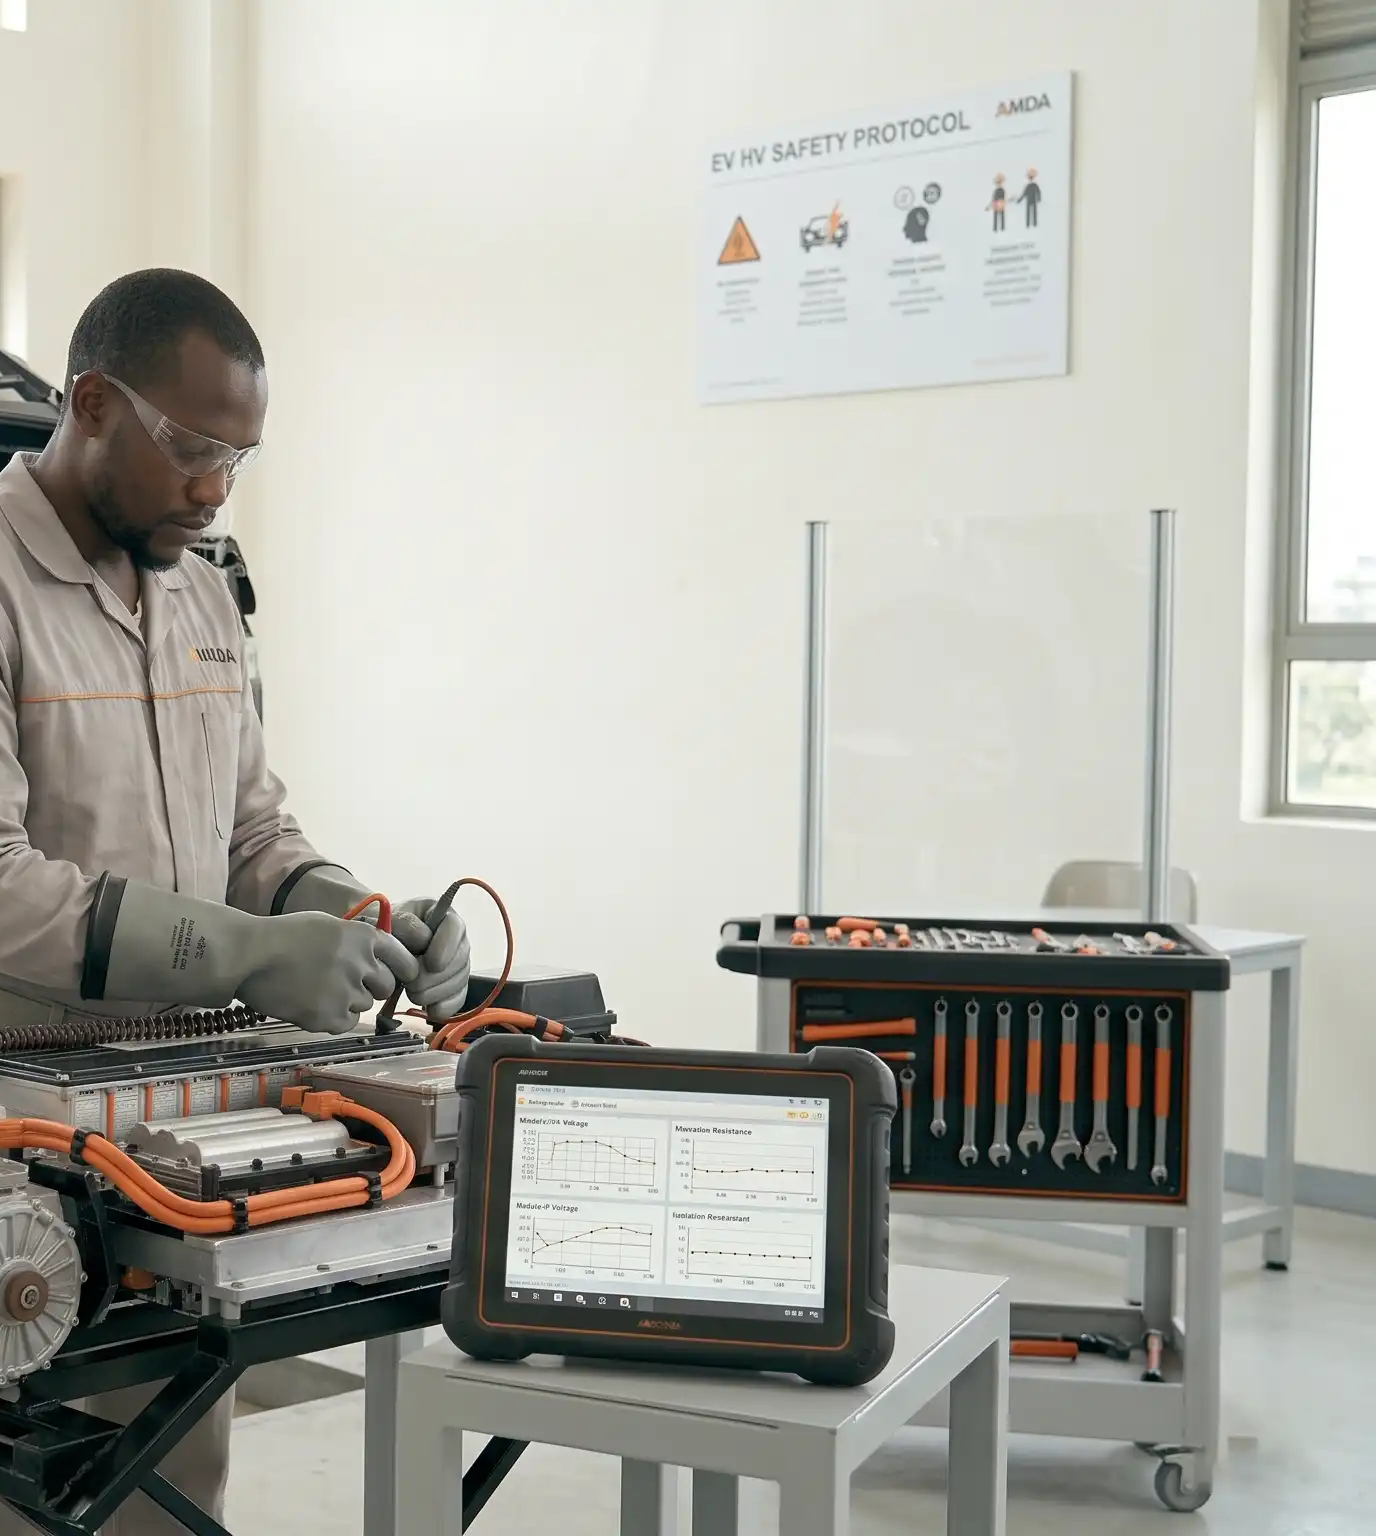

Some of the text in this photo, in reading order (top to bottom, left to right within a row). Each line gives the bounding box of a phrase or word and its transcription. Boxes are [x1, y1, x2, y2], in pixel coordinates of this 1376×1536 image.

[995, 93, 1052, 118] AMDA
[711, 111, 971, 173] EV HV SAFETY PROTOCOL
[712, 1127, 753, 1136] Resistance
[552, 1204, 579, 1213] Voltage
